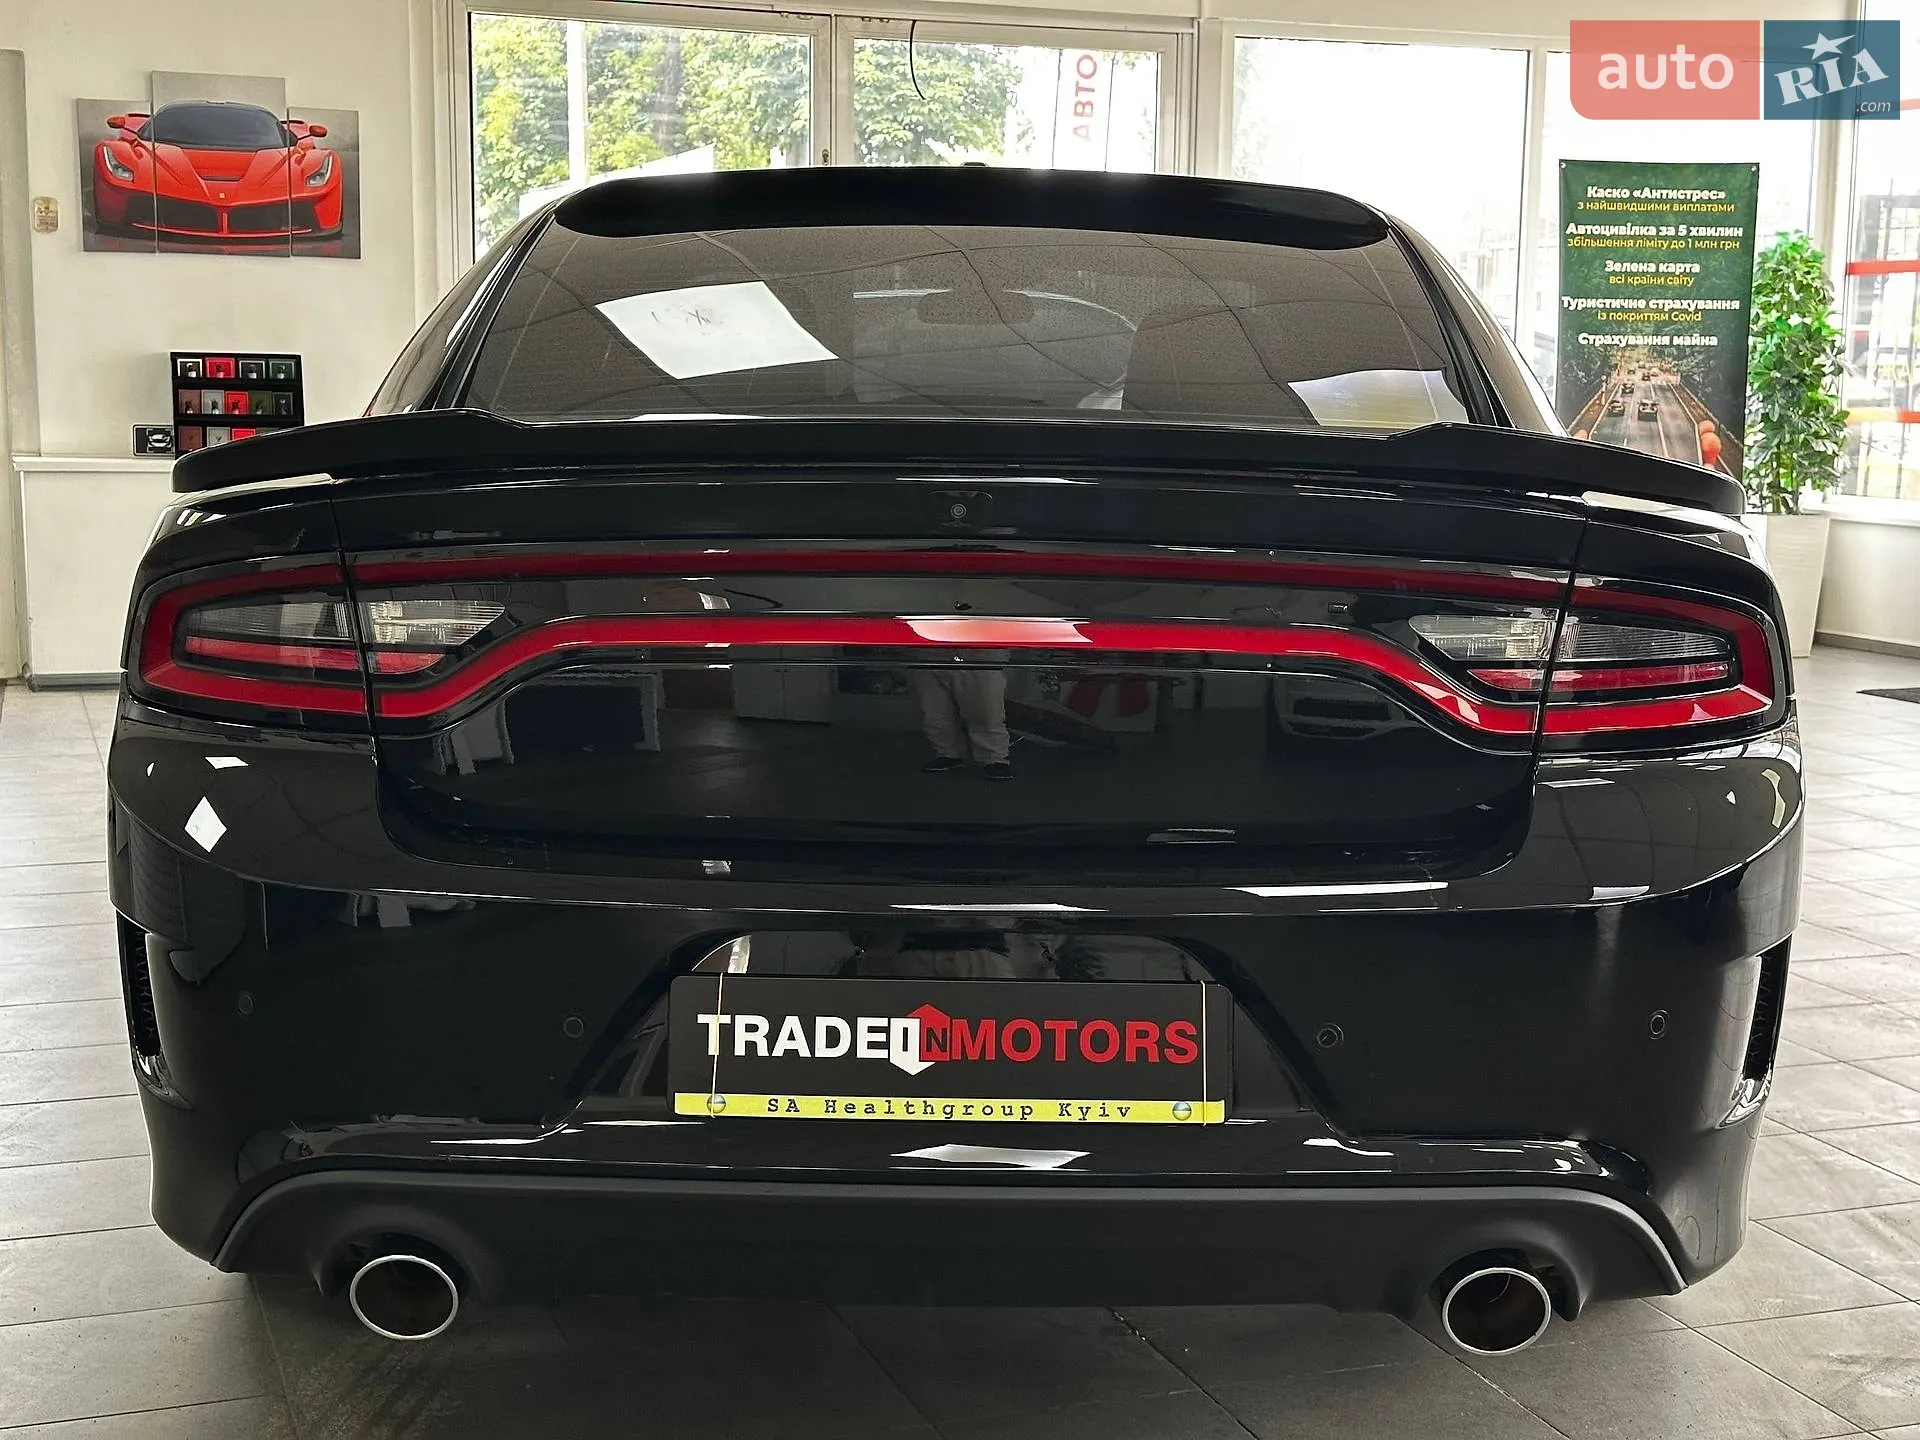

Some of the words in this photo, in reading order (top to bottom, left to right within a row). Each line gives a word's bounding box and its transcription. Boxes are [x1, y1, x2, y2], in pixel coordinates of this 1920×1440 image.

[1072, 54, 1098, 141] АВТО
[1587, 186, 1630, 199] Каско
[1632, 187, 1726, 202] «Антистрес»
[1577, 202, 1584, 210] з
[1586, 200, 1670, 212] найшвидшими
[1673, 203, 1735, 212] виплатами
[1565, 222, 1657, 237] Автоцивілка
[1659, 226, 1676, 236] за
[1678, 224, 1688, 236] 5
[1690, 226, 1743, 237] хвилин
[1567, 236, 1634, 247] збільшення
[1636, 237, 1669, 250] ліміту
[1670, 240, 1686, 249] до
[1687, 238, 1692, 249] 1
[1695, 240, 1718, 249] млн
[1720, 240, 1740, 251] грн
[1604, 260, 1656, 272] Зелена
[1659, 262, 1701, 275] карта
[1609, 274, 1625, 284] всі
[1627, 274, 1665, 286] країни
[1667, 274, 1695, 287] світу
[1561, 296, 1647, 311] Туристичне
[1648, 299, 1740, 312] страхування
[1597, 310, 1607, 320] із
[1609, 312, 1669, 322] покриттям
[1671, 311, 1702, 321] Covid
[1578, 332, 1670, 347] Страхування
[1672, 333, 1718, 346] майна
[766, 1097, 801, 1114] SA
[824, 1098, 1034, 1120] Healthgroup
[1058, 1101, 1132, 1122] Kyiv
